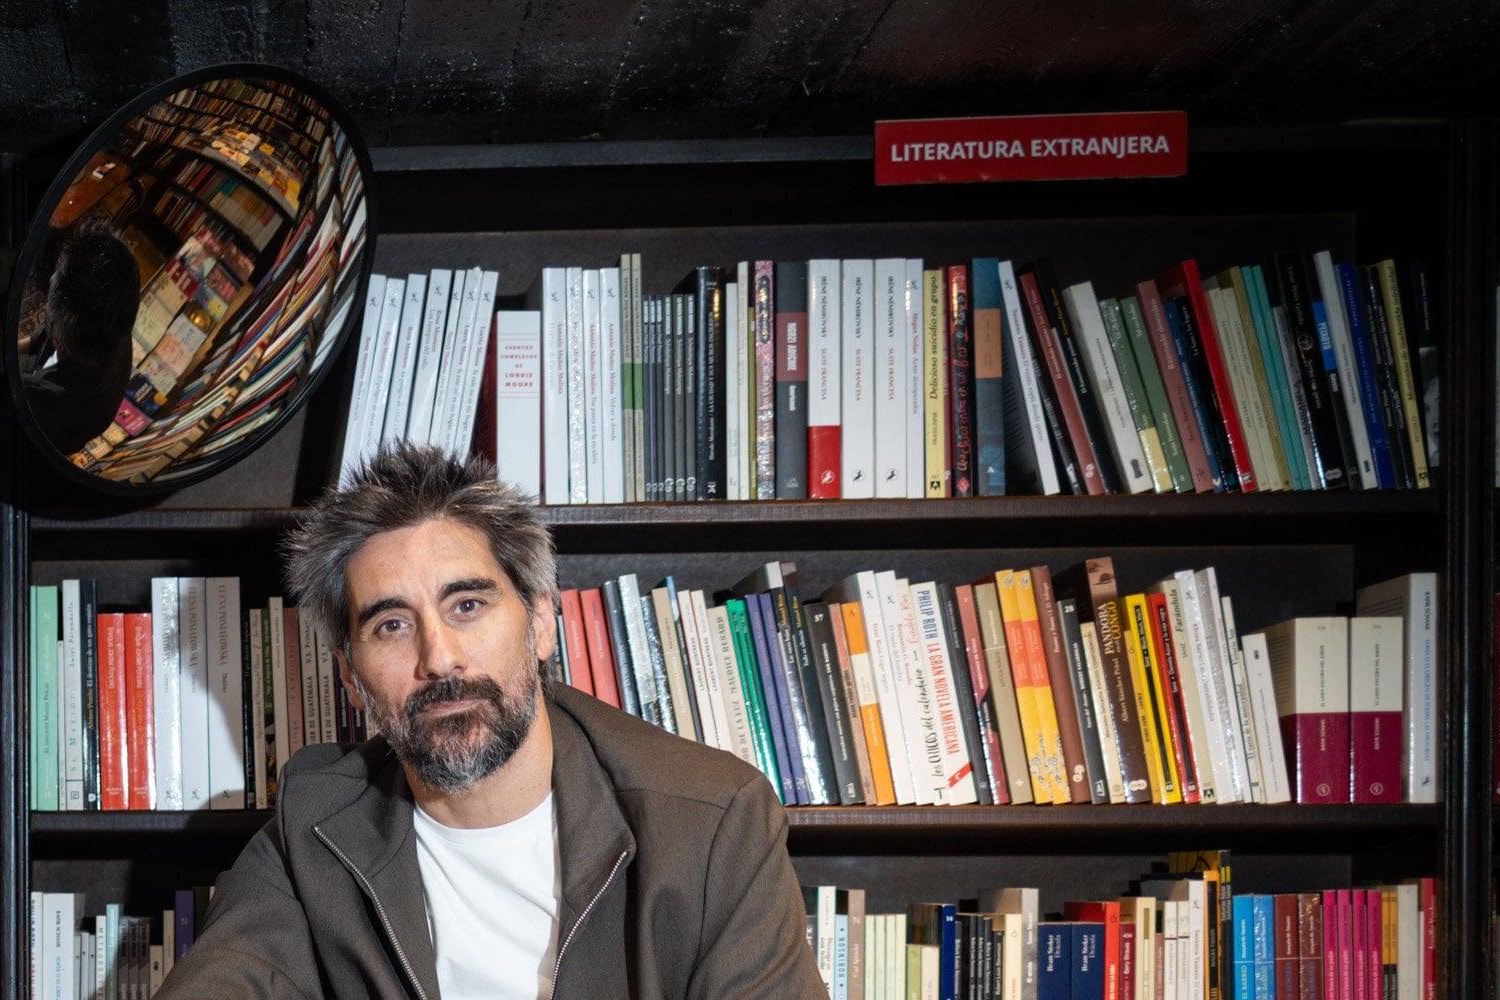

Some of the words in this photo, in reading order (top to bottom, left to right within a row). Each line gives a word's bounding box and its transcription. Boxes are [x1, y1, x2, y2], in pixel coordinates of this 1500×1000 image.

[890, 138, 1025, 163] LITERATURA
[1030, 134, 1171, 158] EXTRANJERA
[930, 306, 937, 316] en
[930, 357, 938, 399] Delicioso
[917, 590, 934, 616] PHILIP
[1169, 589, 1183, 632] Farándula
[922, 619, 938, 639] ROTH
[1097, 603, 1115, 654] PANDORA
[1105, 602, 1121, 639] CONGO
[927, 643, 941, 653] LA
[929, 656, 945, 676] GRAN
[307, 675, 315, 717] GUATEMALA
[933, 678, 951, 707] NOVELA
[309, 719, 315, 727] DE
[939, 710, 960, 755] AMERICANA
